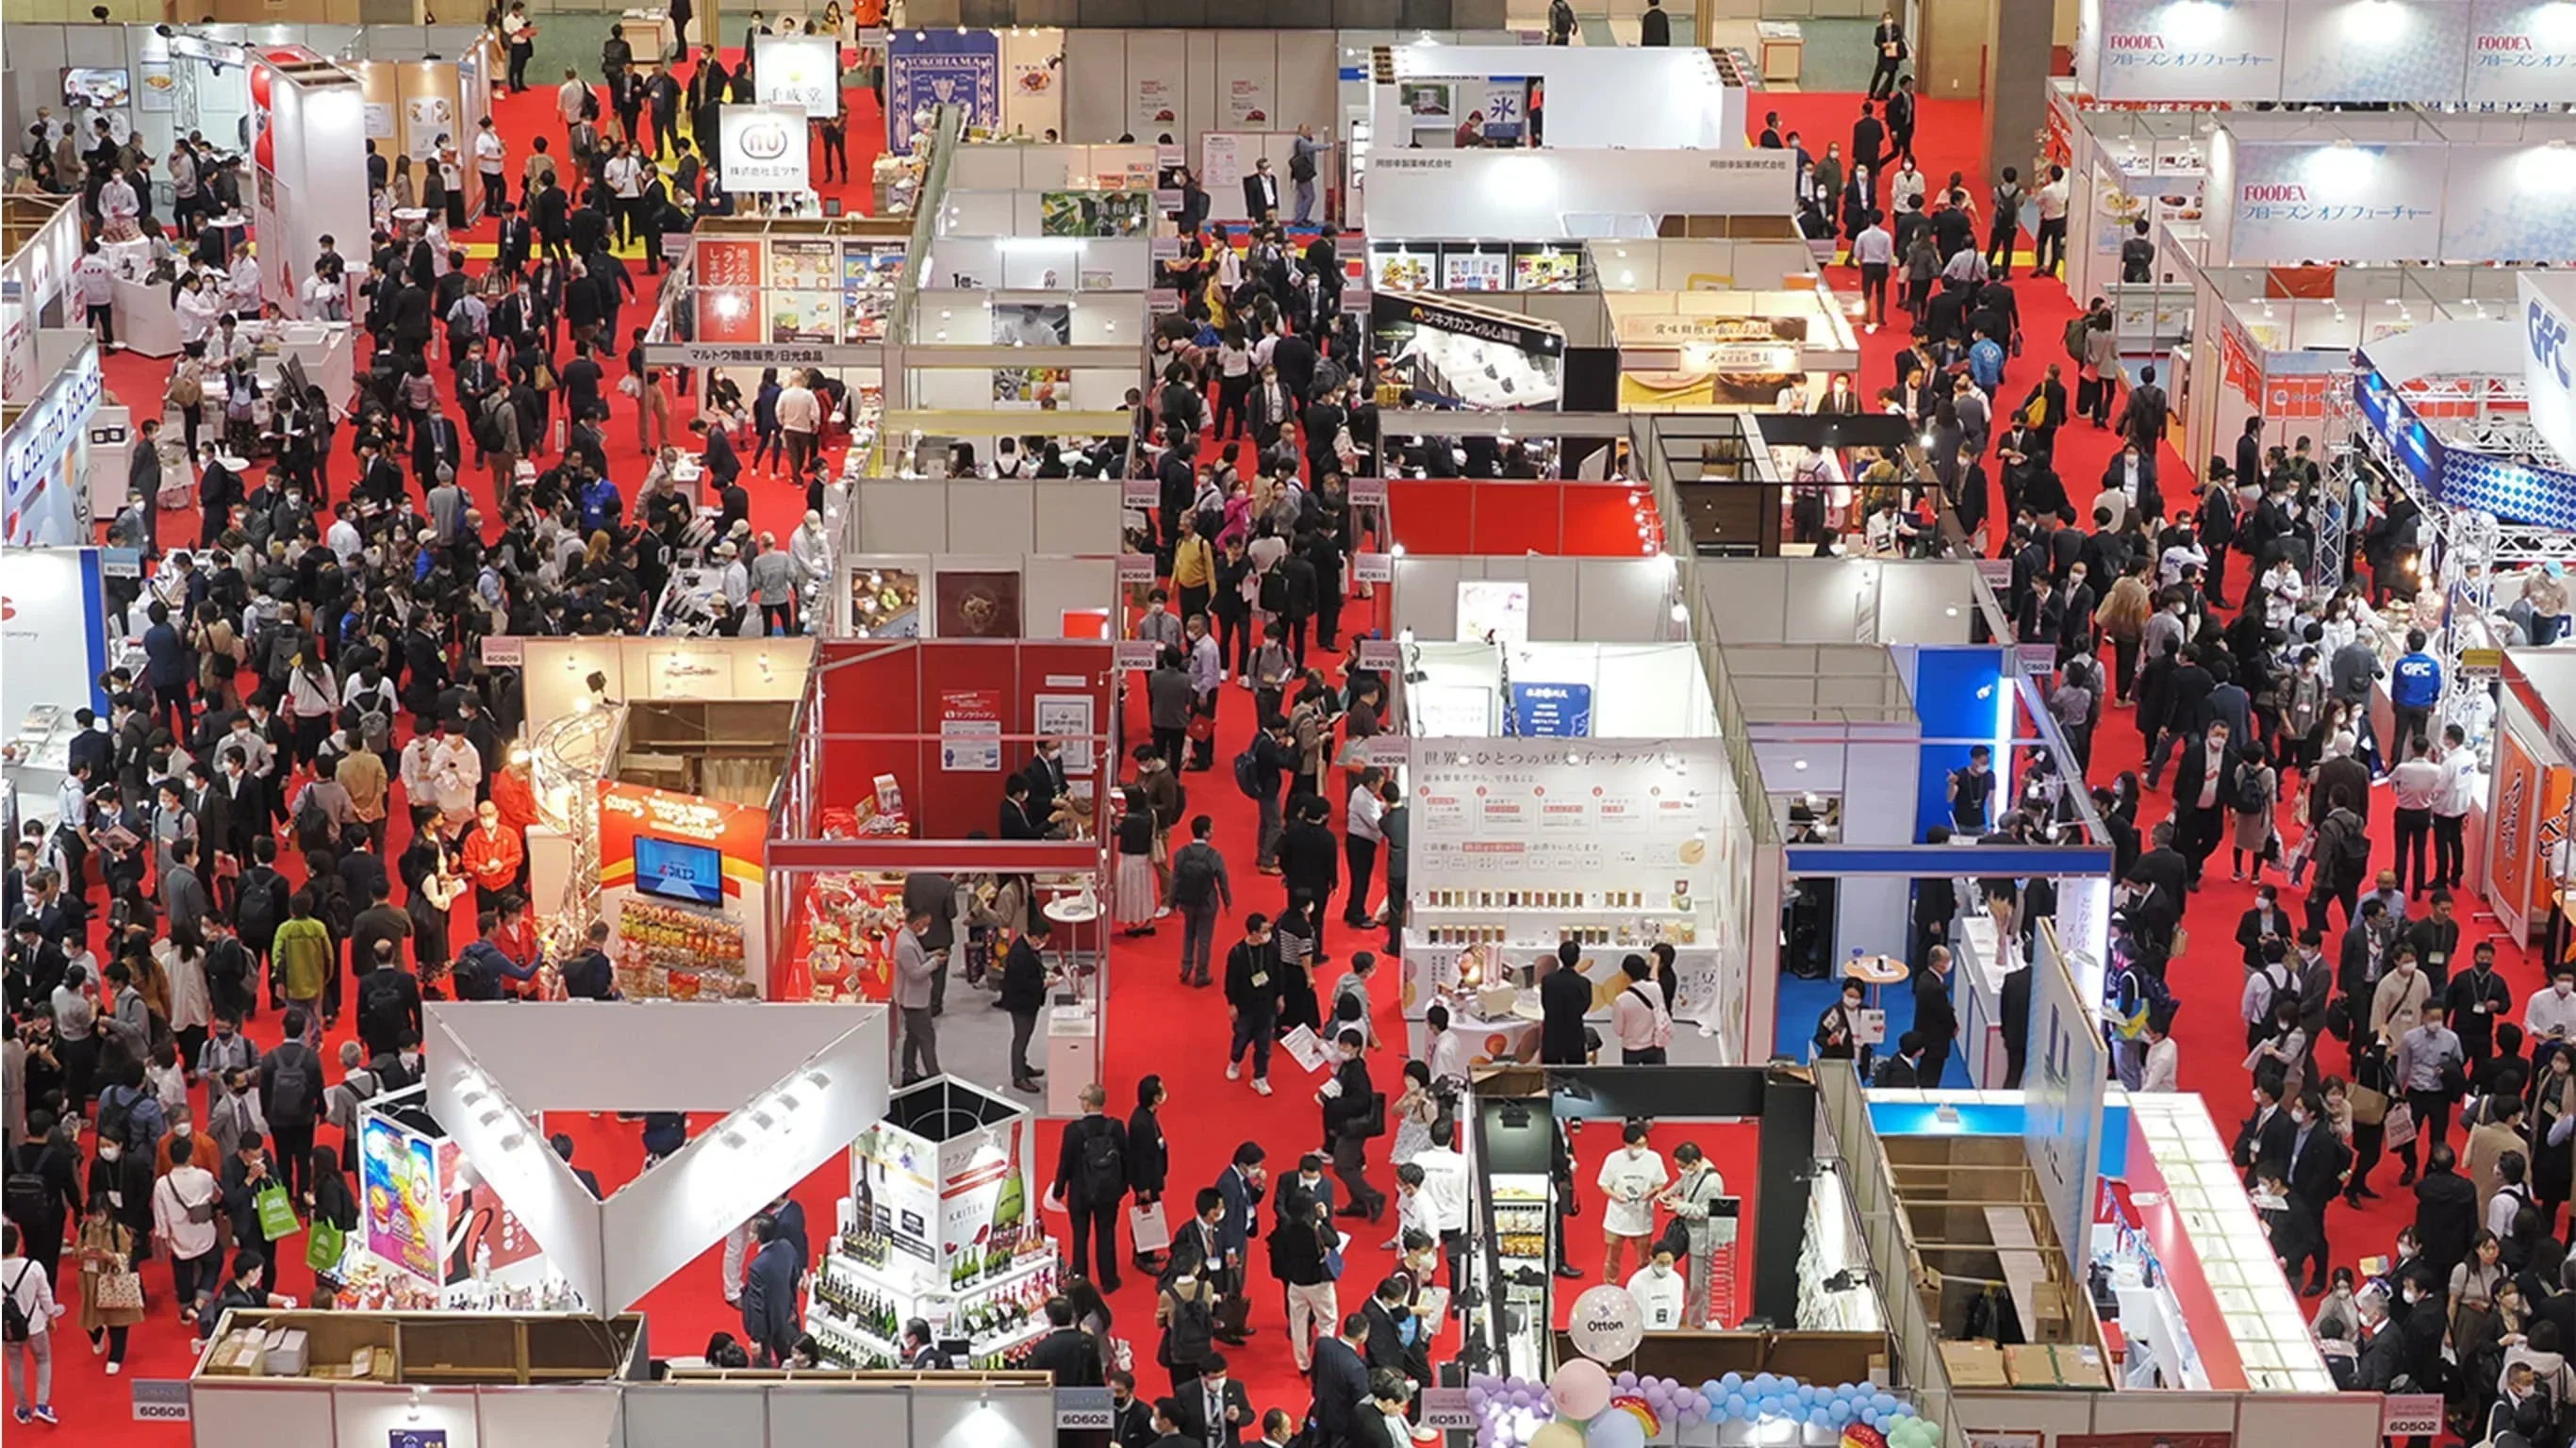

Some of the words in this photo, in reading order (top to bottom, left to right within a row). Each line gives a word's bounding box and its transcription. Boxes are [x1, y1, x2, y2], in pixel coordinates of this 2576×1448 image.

[2110, 36, 2165, 49] FOODEX
[2477, 37, 2533, 50] FOODEX
[905, 58, 980, 67] YOKOHAMA
[2110, 53, 2170, 66] フローズン
[2204, 52, 2274, 66] フューチャー
[2478, 54, 2537, 67] フローズン
[1491, 97, 1516, 122] 氷
[2244, 185, 2307, 202] FOODEX
[2244, 205, 2314, 220] フローズン
[2352, 205, 2432, 221] フューチャー
[690, 349, 823, 362] マルトウ物産販売/日光食品
[2402, 662, 2432, 676] GFC
[1587, 1320, 1624, 1333] Otton
[1062, 1414, 1110, 1425] 6D602
[1428, 1414, 1471, 1425] 6D511
[2389, 1421, 2437, 1432] 6D502
